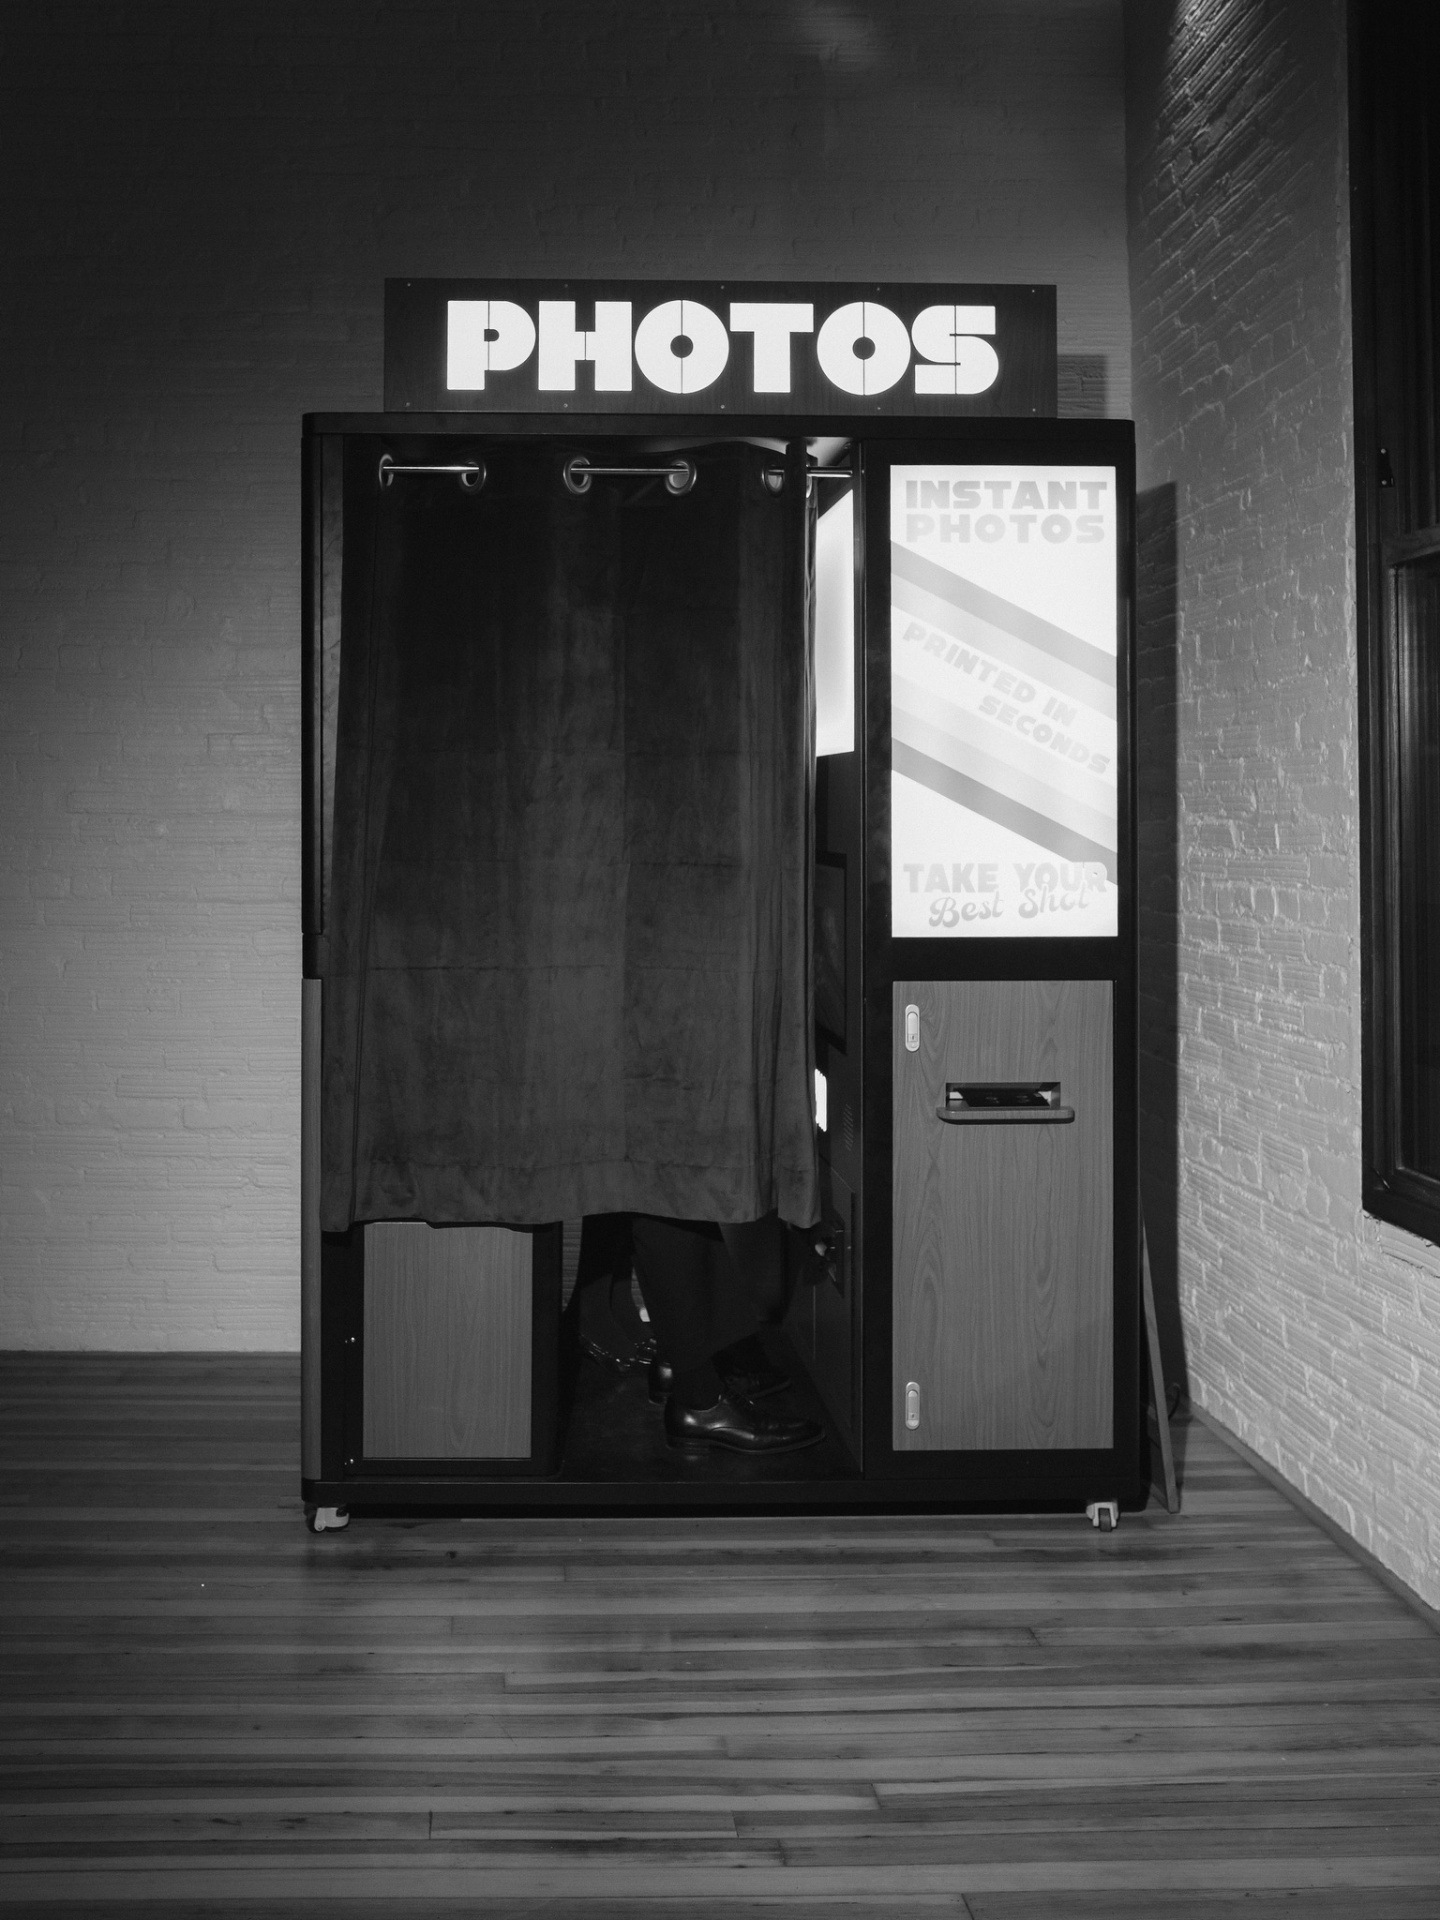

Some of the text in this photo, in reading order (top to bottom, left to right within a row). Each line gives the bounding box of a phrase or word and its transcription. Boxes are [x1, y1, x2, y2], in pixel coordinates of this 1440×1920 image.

[447, 300, 999, 395] PHOTOS
[906, 480, 1107, 509] INSTANT
[906, 513, 1105, 544] PHOTOS
[903, 621, 1078, 727] PRINTED IN
[979, 695, 1111, 774] SECONDS
[903, 862, 1107, 893] TAKE YOUR
[928, 881, 1091, 928] Best Shot
